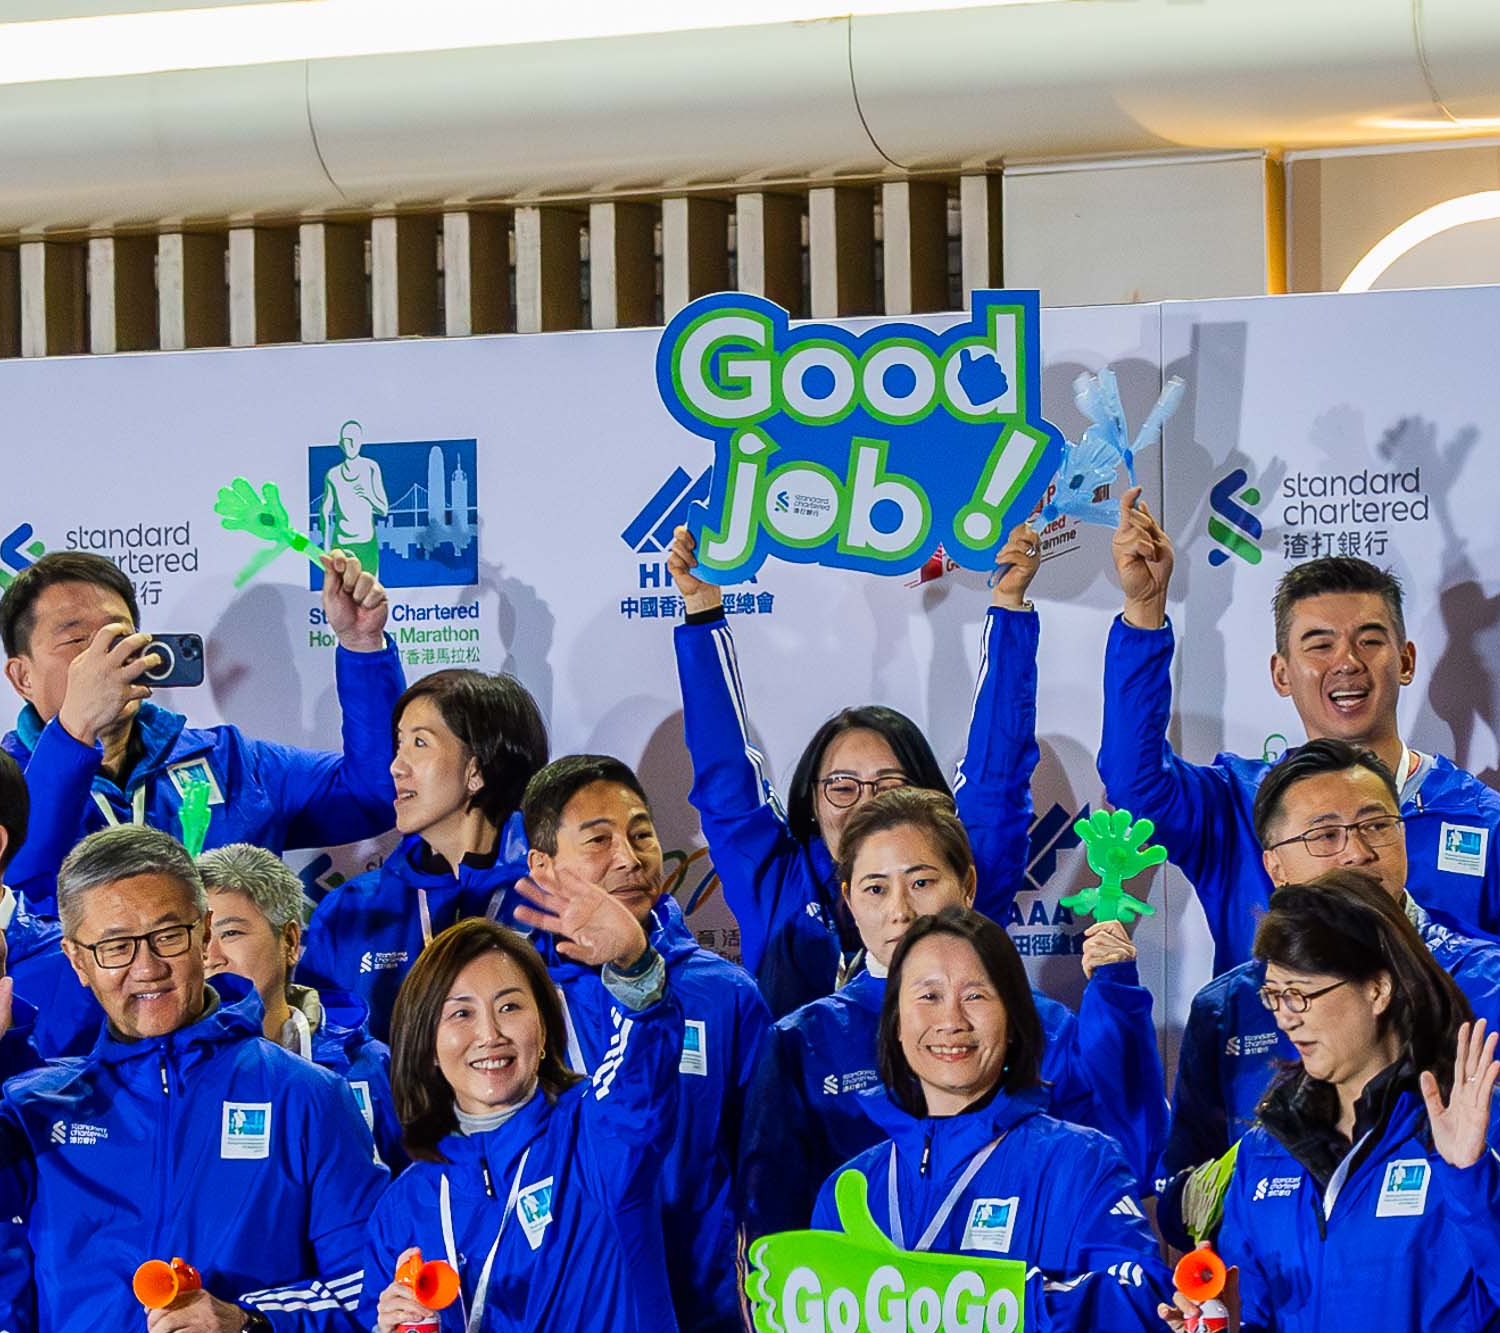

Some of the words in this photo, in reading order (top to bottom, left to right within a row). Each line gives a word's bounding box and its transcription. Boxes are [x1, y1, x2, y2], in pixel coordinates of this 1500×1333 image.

[678, 312, 1018, 420] Good
[1283, 467, 1420, 498] standard
[1283, 494, 1429, 526] chartered
[65, 520, 191, 552] standard
[1283, 530, 1388, 559] 渣打銀行
[392, 601, 480, 622] Chartered
[400, 626, 480, 644] Marathon
